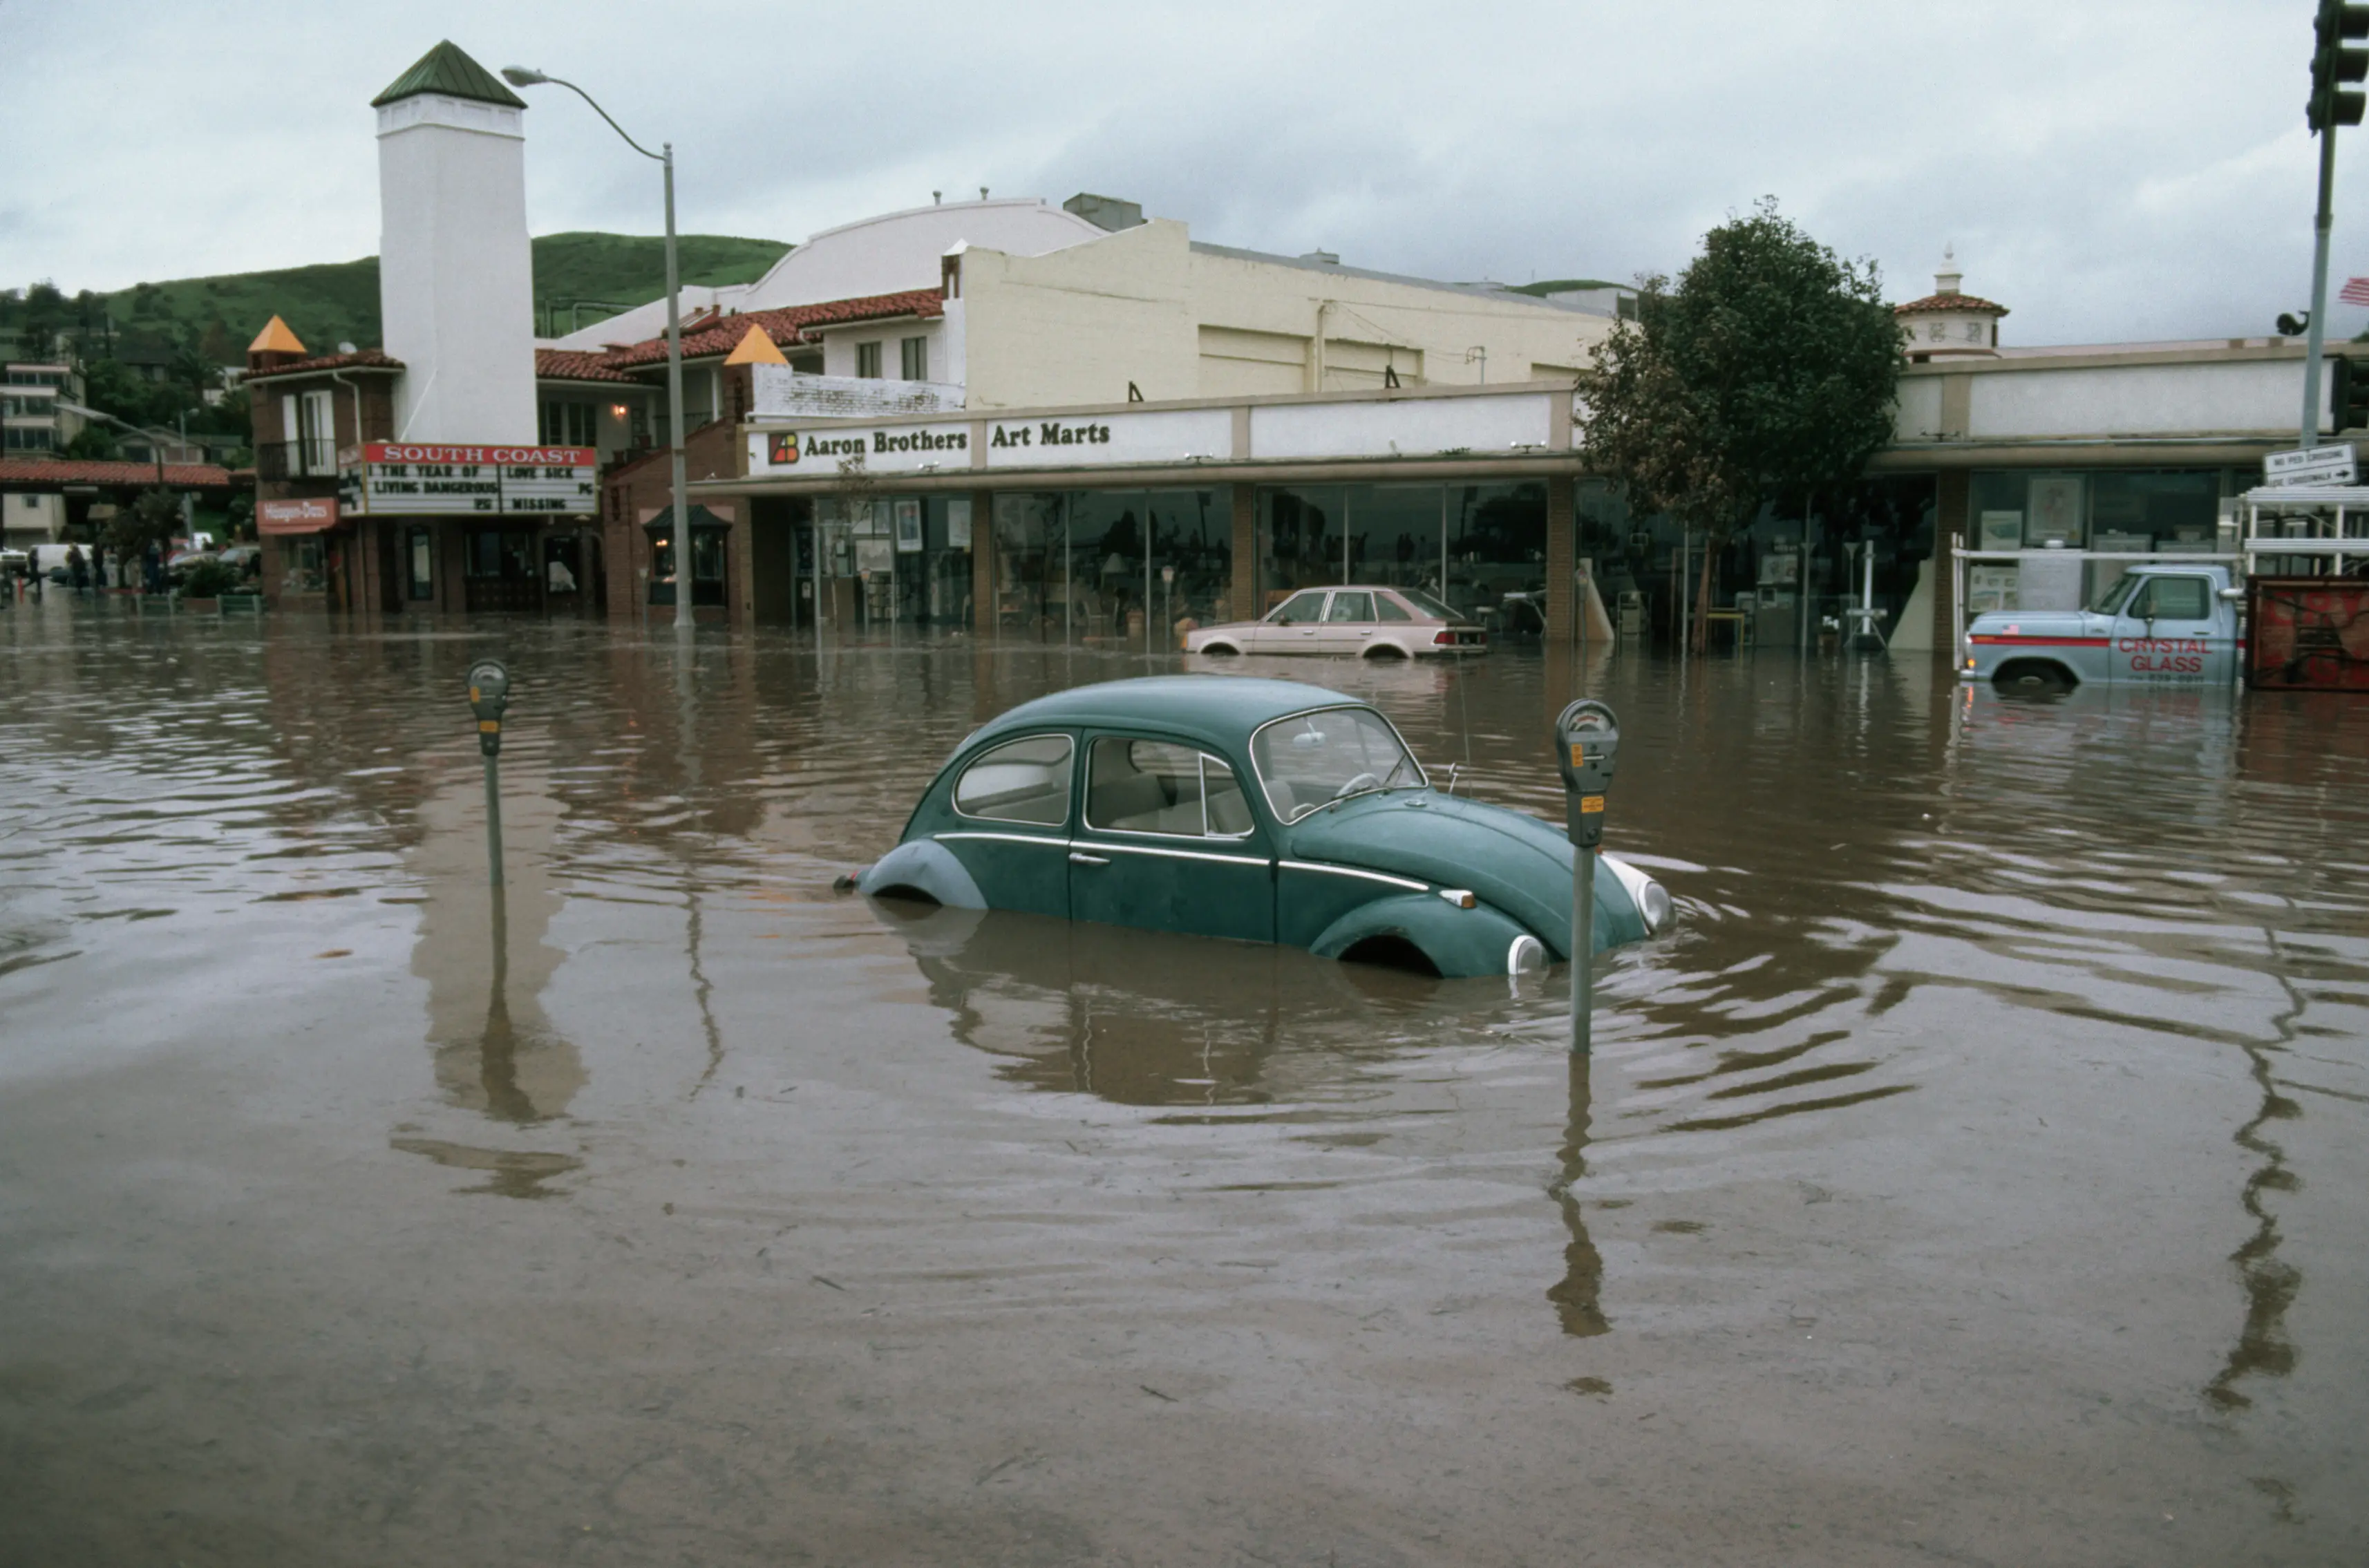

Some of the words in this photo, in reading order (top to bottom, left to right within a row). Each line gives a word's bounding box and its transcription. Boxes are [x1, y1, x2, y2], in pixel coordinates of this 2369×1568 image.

[804, 435, 866, 456] Aaron
[873, 430, 967, 453] Brothers
[991, 424, 1031, 447] Art
[1040, 422, 1111, 445] Marts
[384, 446, 484, 462] SOUTH
[492, 448, 581, 464] COAST
[416, 464, 453, 478] YEAR
[374, 480, 419, 494] LIVING
[511, 498, 567, 511] MISSING
[2118, 637, 2213, 654] CRYSTAL
[2131, 655, 2203, 673] GLASS
